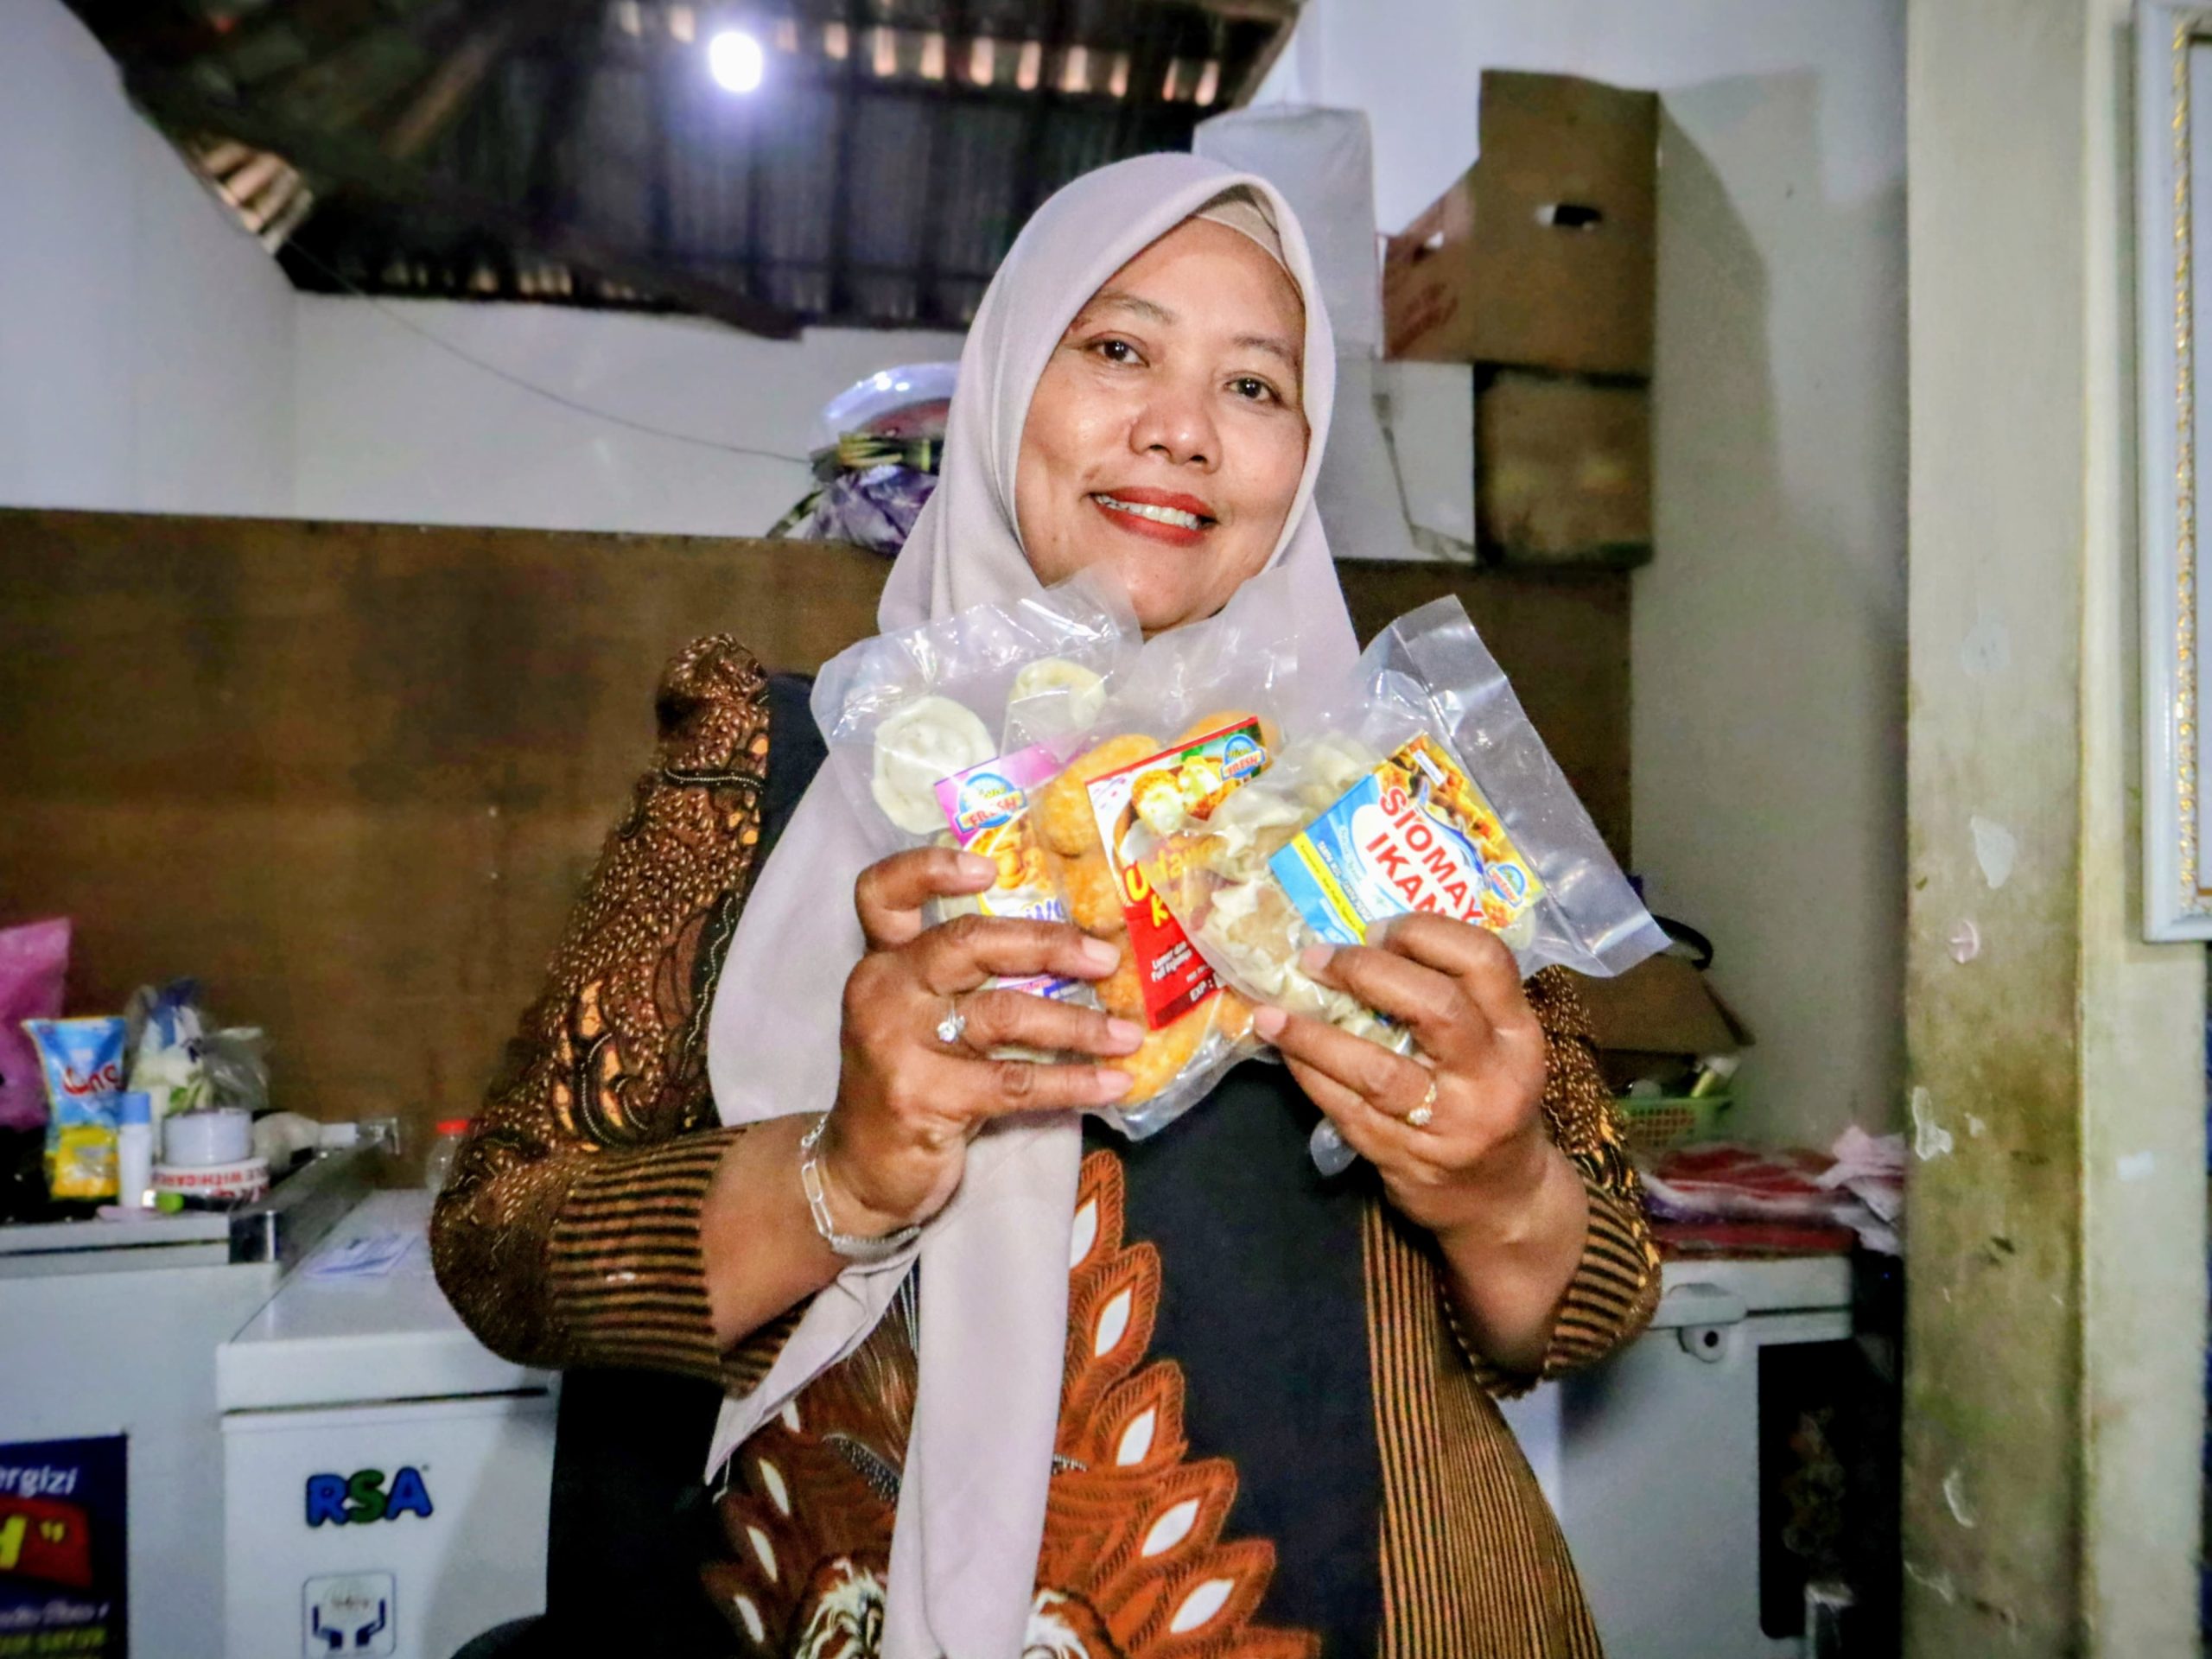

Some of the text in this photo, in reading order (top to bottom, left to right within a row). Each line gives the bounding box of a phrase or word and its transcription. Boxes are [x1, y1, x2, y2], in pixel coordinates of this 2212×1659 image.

[1380, 788, 1484, 922] SIOMAY
[1190, 981, 1206, 1002] EXP
[306, 1465, 434, 1529] RSA
